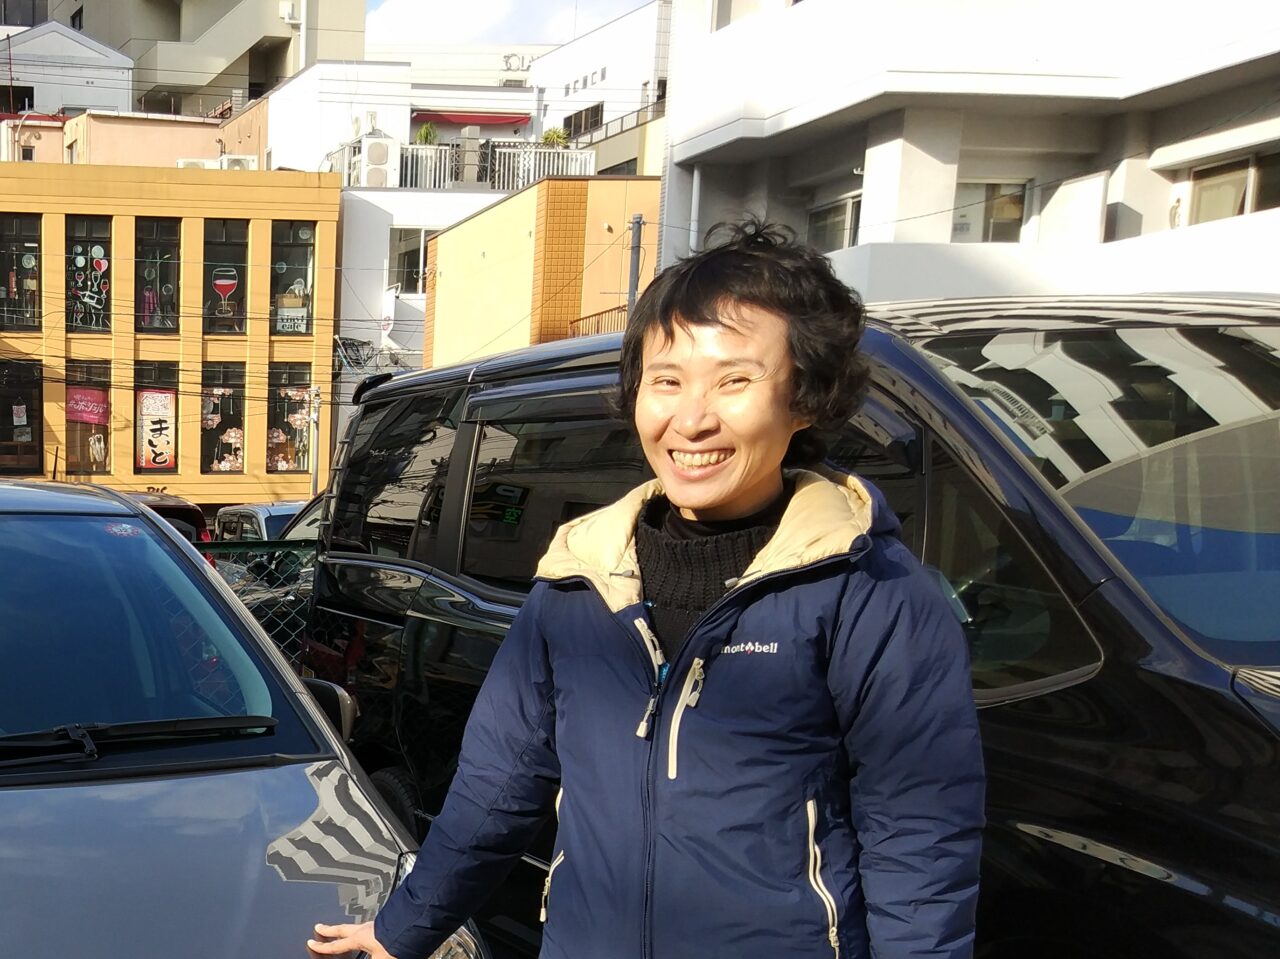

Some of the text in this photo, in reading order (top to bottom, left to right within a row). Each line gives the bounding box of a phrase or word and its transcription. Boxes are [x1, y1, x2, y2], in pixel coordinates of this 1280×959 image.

[147, 418, 171, 465] まいど
[754, 641, 779, 654] bell
